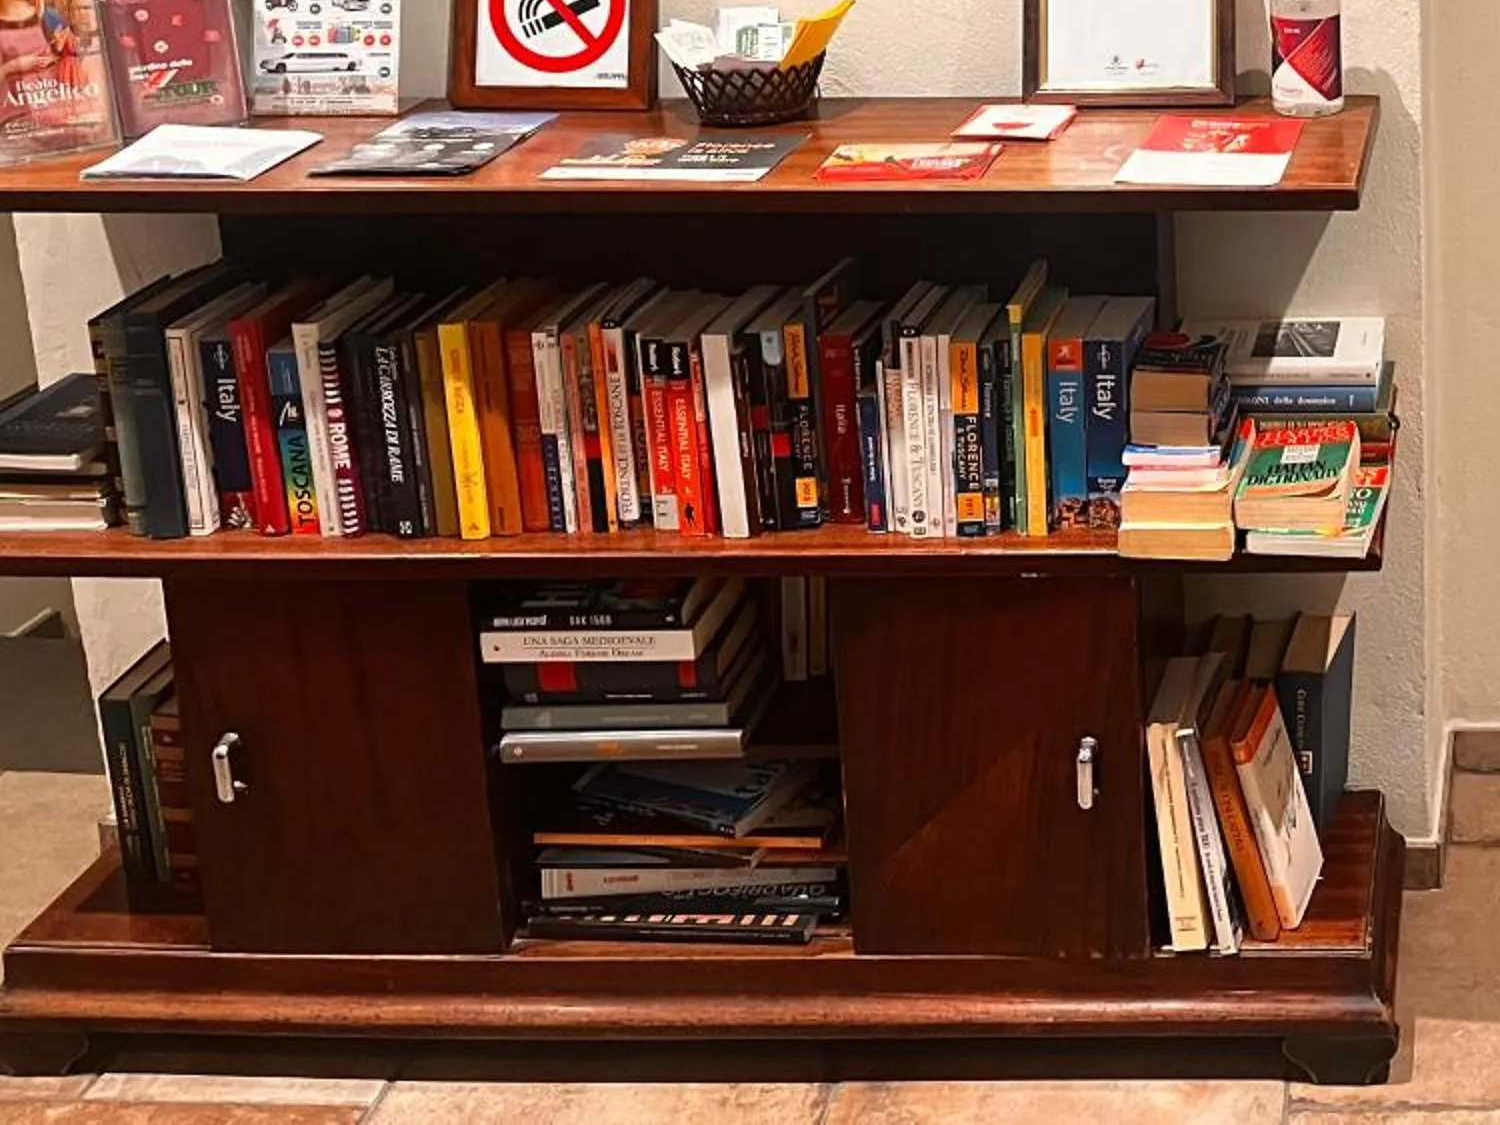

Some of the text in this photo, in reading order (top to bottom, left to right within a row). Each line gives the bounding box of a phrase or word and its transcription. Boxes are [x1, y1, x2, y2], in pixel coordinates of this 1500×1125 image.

[2, 82, 99, 109] Angelico
[216, 378, 240, 423] Italy
[1056, 381, 1079, 424] Italy
[1093, 374, 1117, 420] Italy
[329, 423, 351, 470] ROME
[651, 390, 670, 473] ESSENTIAL ITALY
[675, 397, 692, 480] ESSENTIAL ITALY
[966, 416, 980, 491] FLORENCE
[287, 434, 313, 525] TOSCANA
[388, 446, 405, 484] RAME
[956, 436, 967, 480] TUSCANY
[617, 457, 633, 514] FLORENCE
[523, 636, 549, 646] UNA
[552, 636, 579, 646] SAGA
